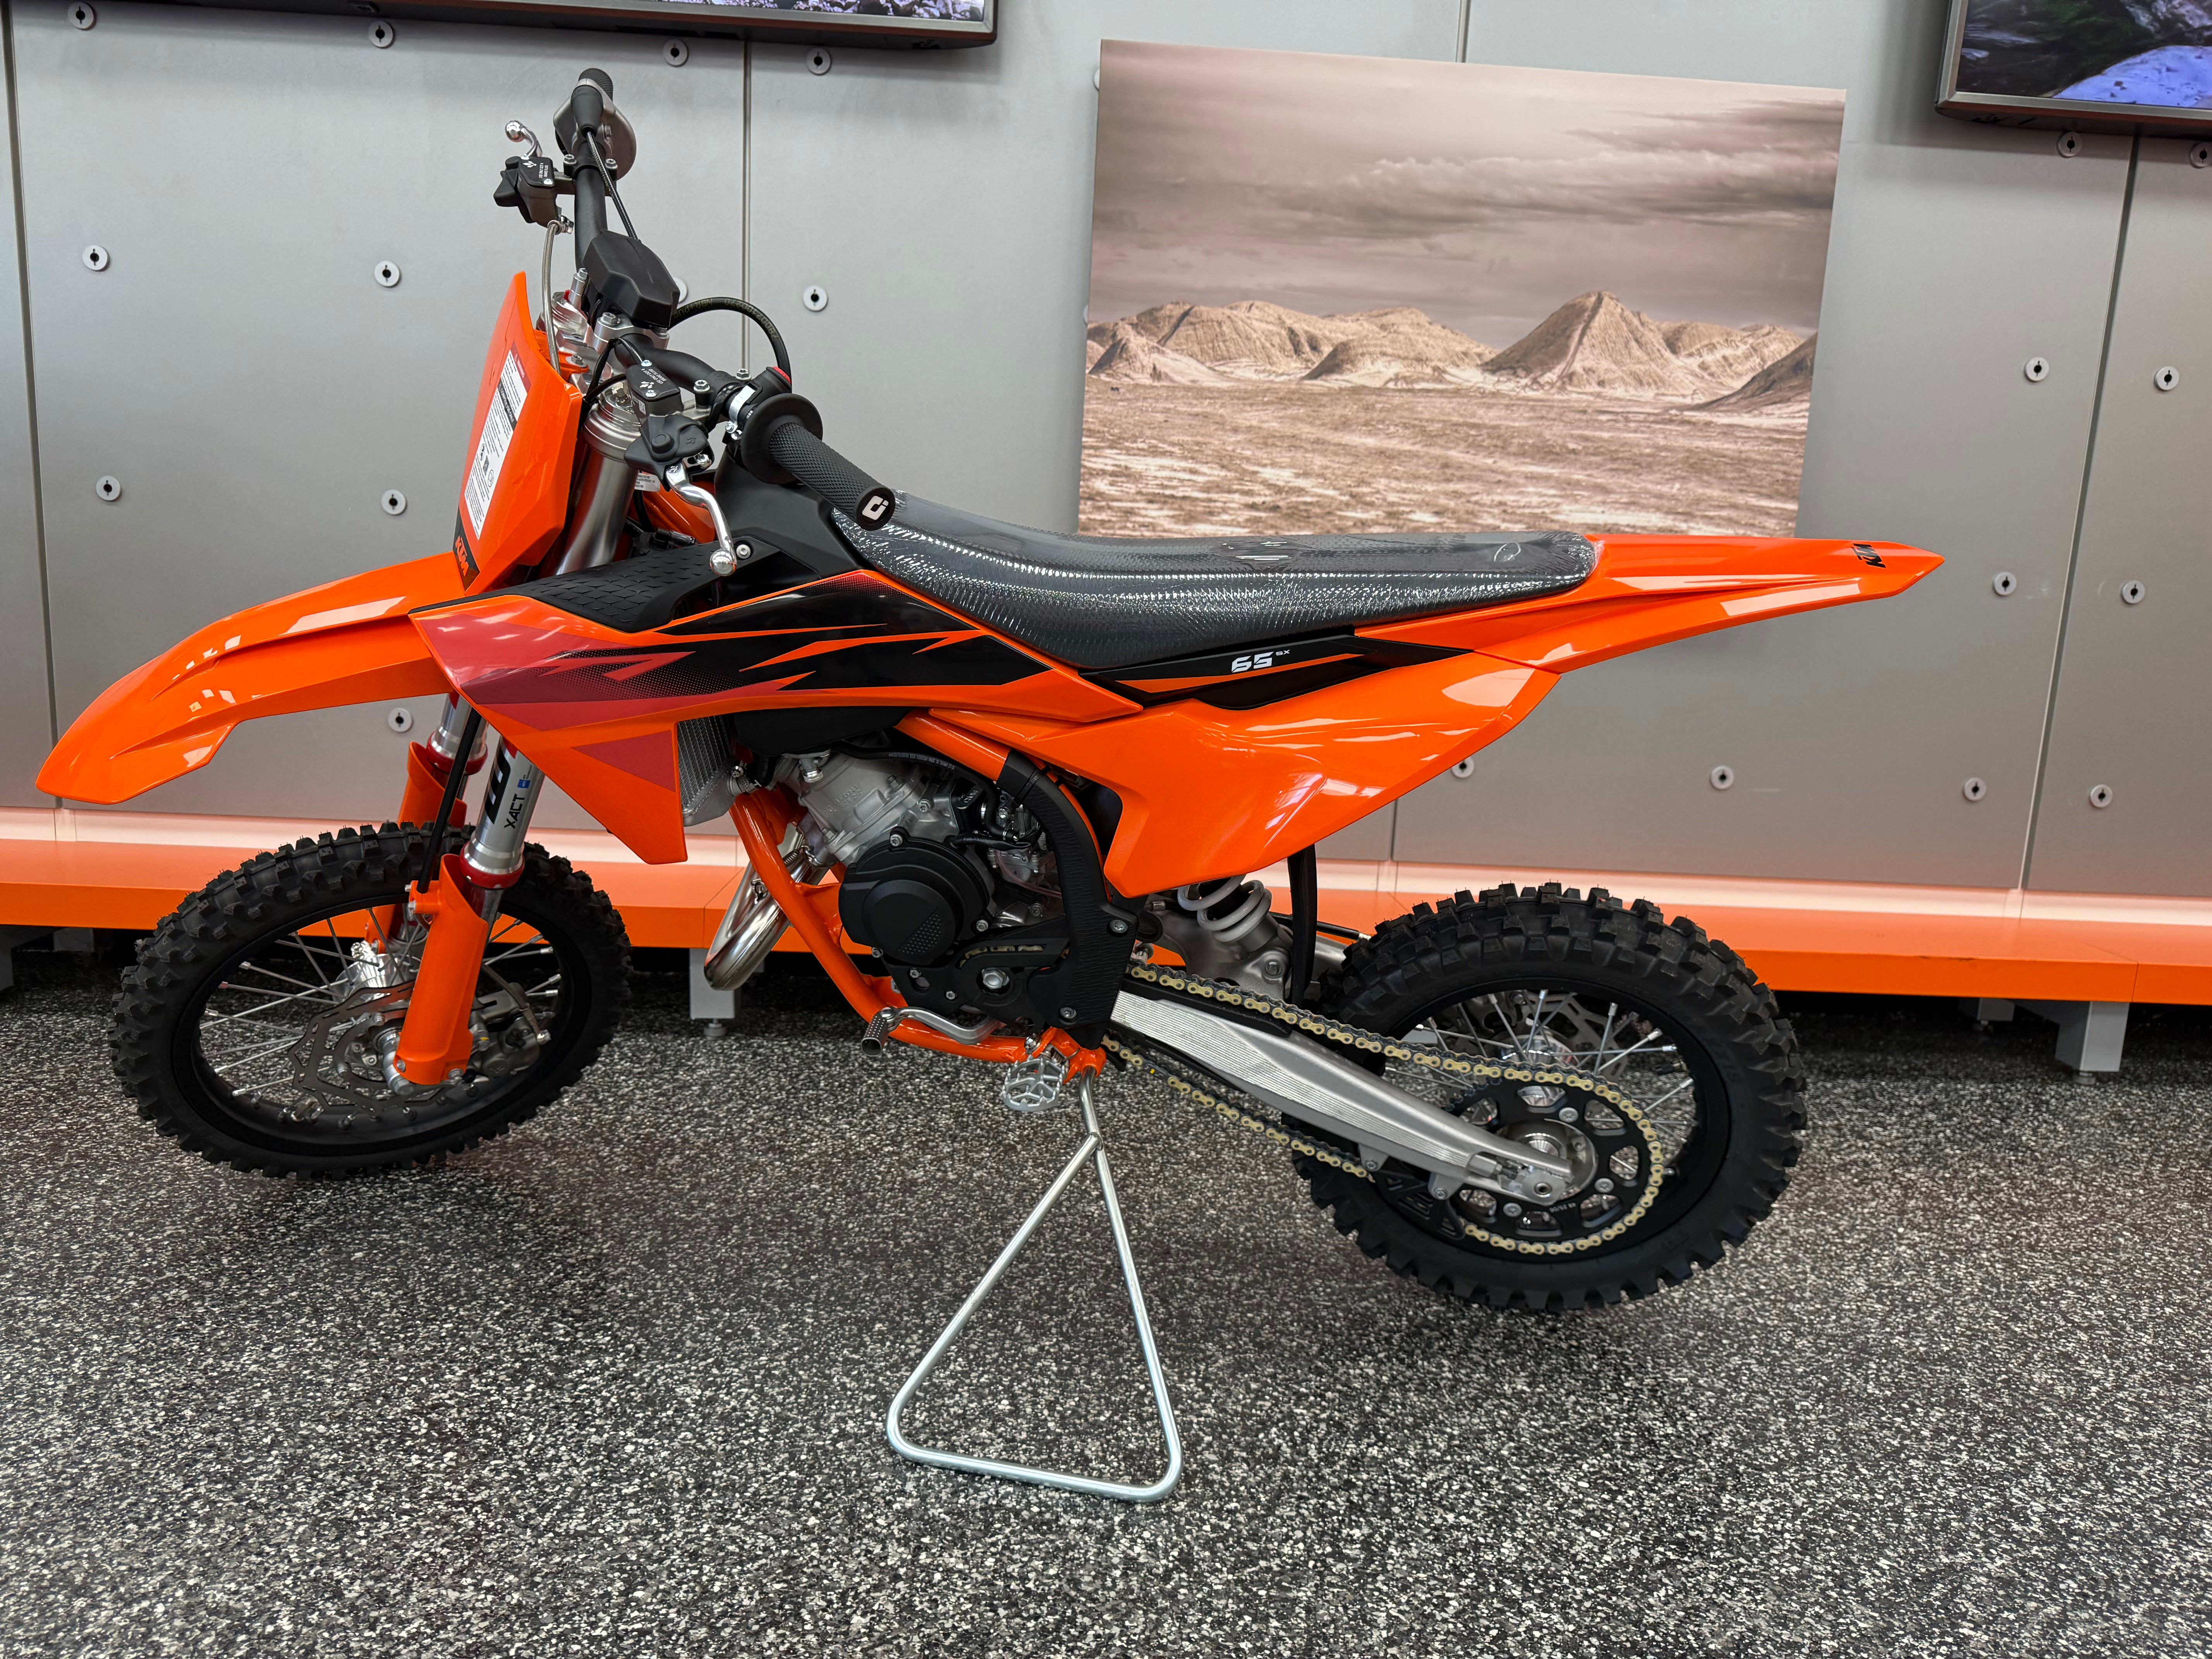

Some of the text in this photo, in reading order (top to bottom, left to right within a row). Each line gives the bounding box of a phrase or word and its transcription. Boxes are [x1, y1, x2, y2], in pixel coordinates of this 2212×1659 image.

[455, 535, 469, 577] KTM
[1851, 543, 1887, 569] KTM
[1231, 651, 1274, 673] 65
[503, 793, 525, 829] XACT
